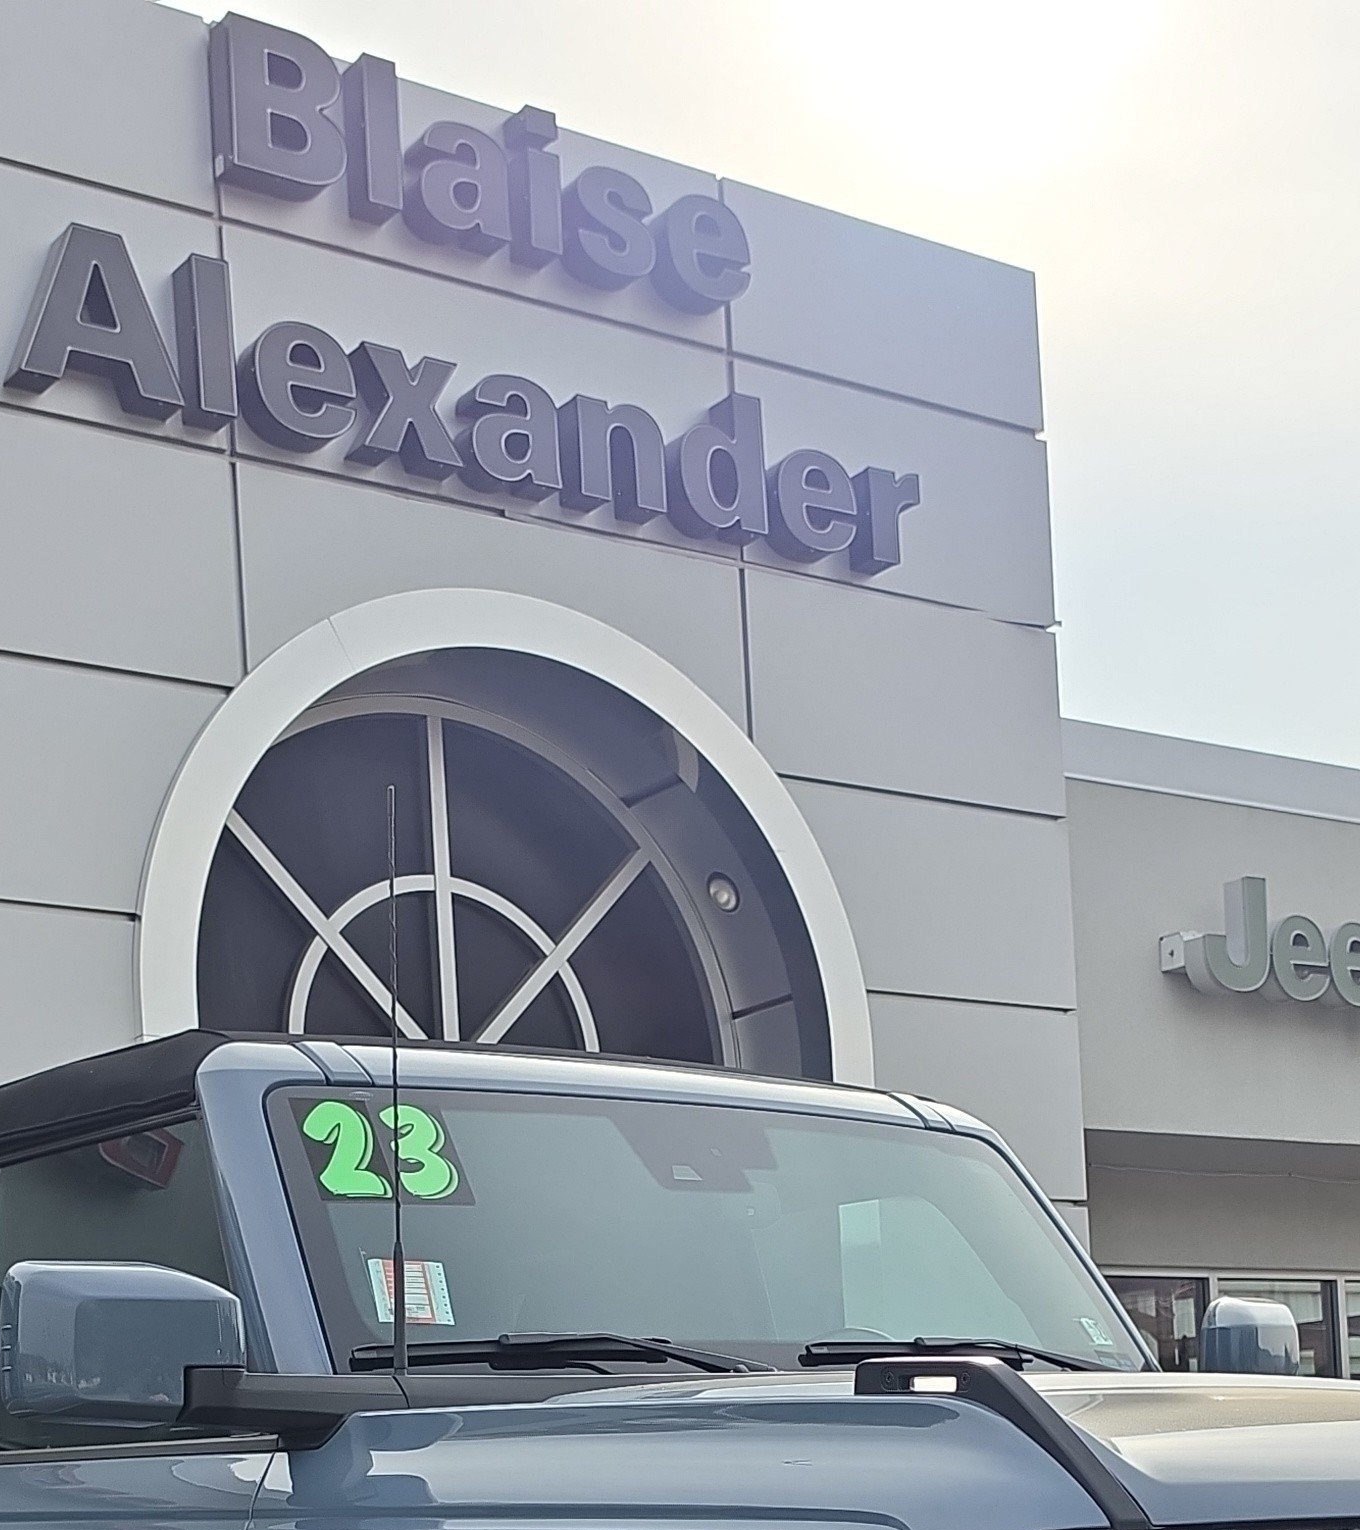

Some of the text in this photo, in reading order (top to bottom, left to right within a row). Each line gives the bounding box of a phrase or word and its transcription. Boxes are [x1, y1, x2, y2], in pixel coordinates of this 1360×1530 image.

[209, 11, 752, 315] Blaise
[4, 223, 921, 577] Alexander
[301, 1099, 462, 1201] 23
